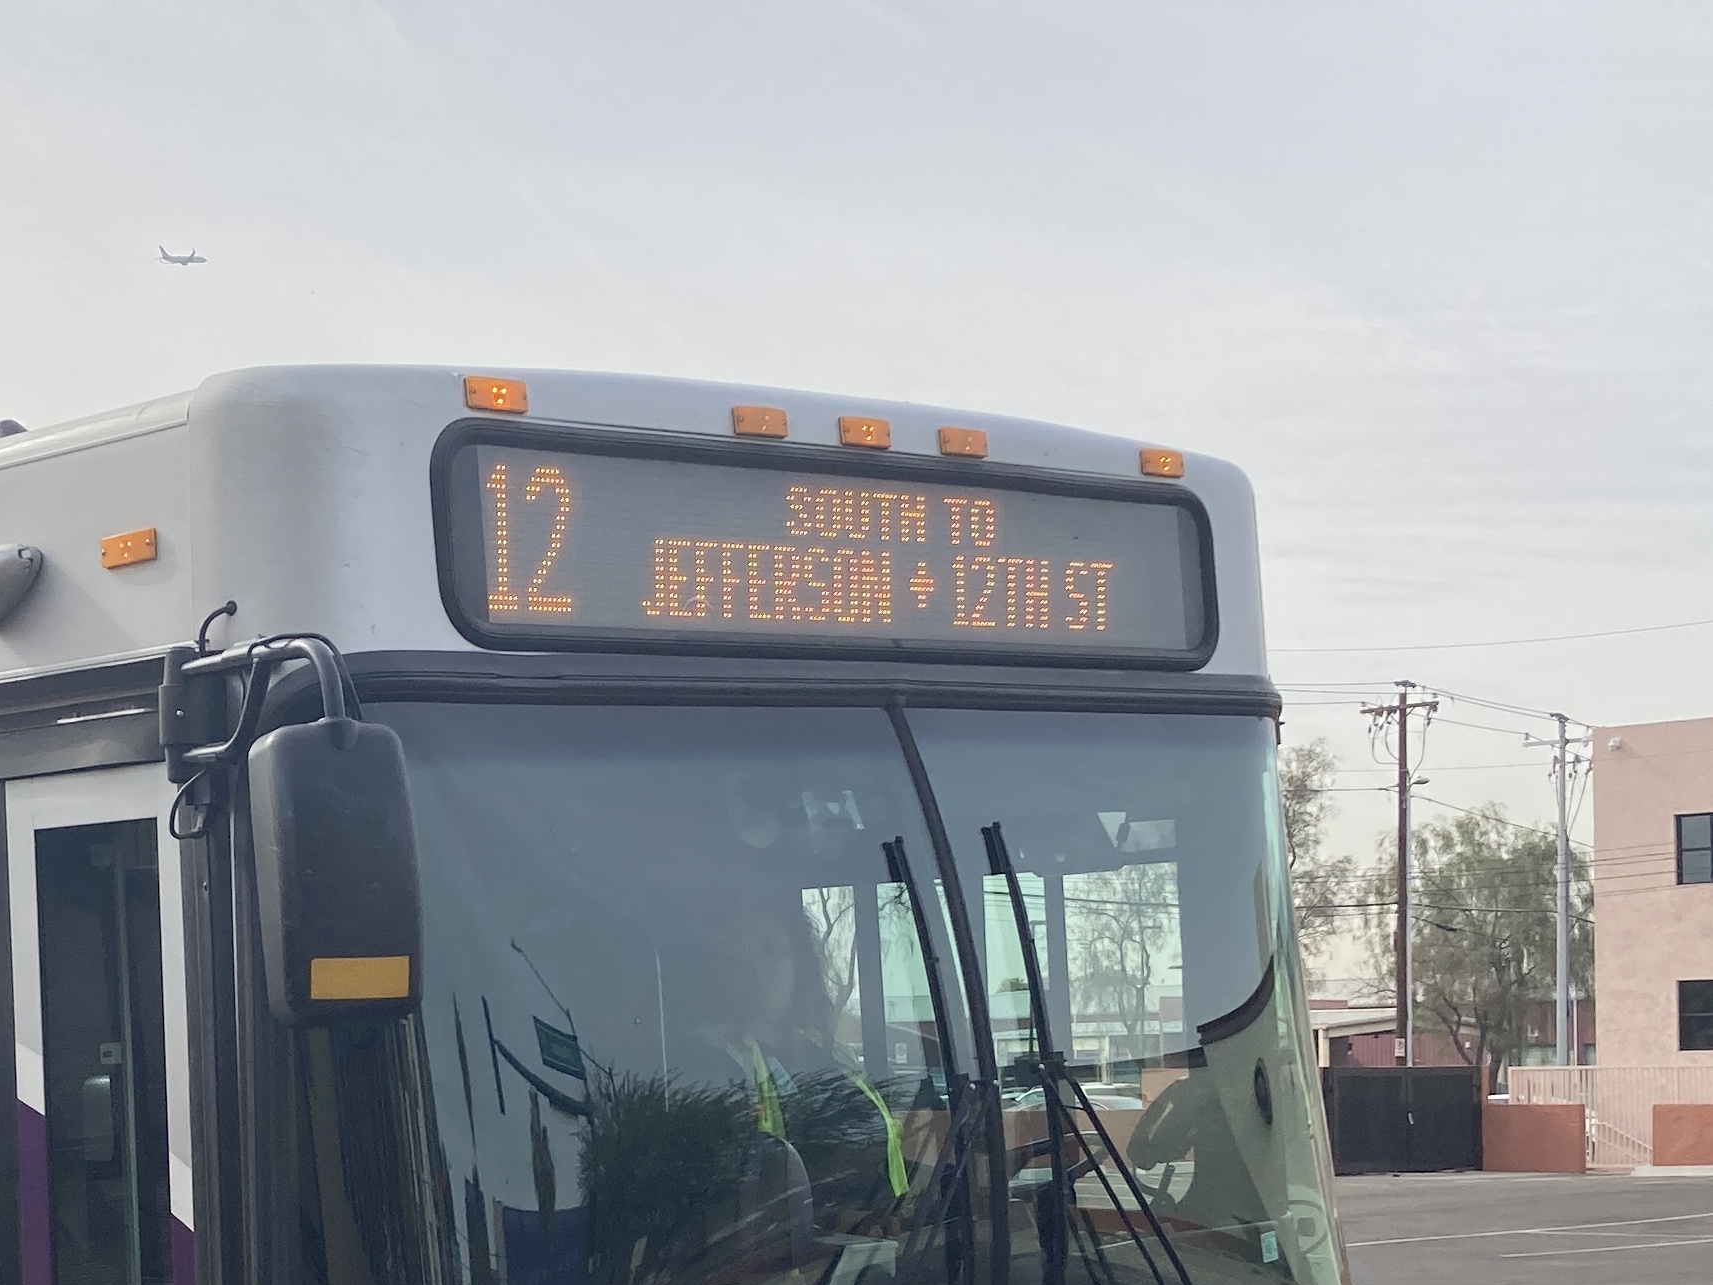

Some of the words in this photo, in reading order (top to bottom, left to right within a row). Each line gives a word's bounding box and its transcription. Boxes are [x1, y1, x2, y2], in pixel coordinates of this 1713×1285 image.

[485, 461, 573, 612] 12
[785, 486, 927, 544] SOUTH
[942, 496, 997, 549] TO
[642, 537, 892, 624] JEFFERSON
[952, 554, 1050, 630] 12TH
[1065, 561, 1115, 631] ST
